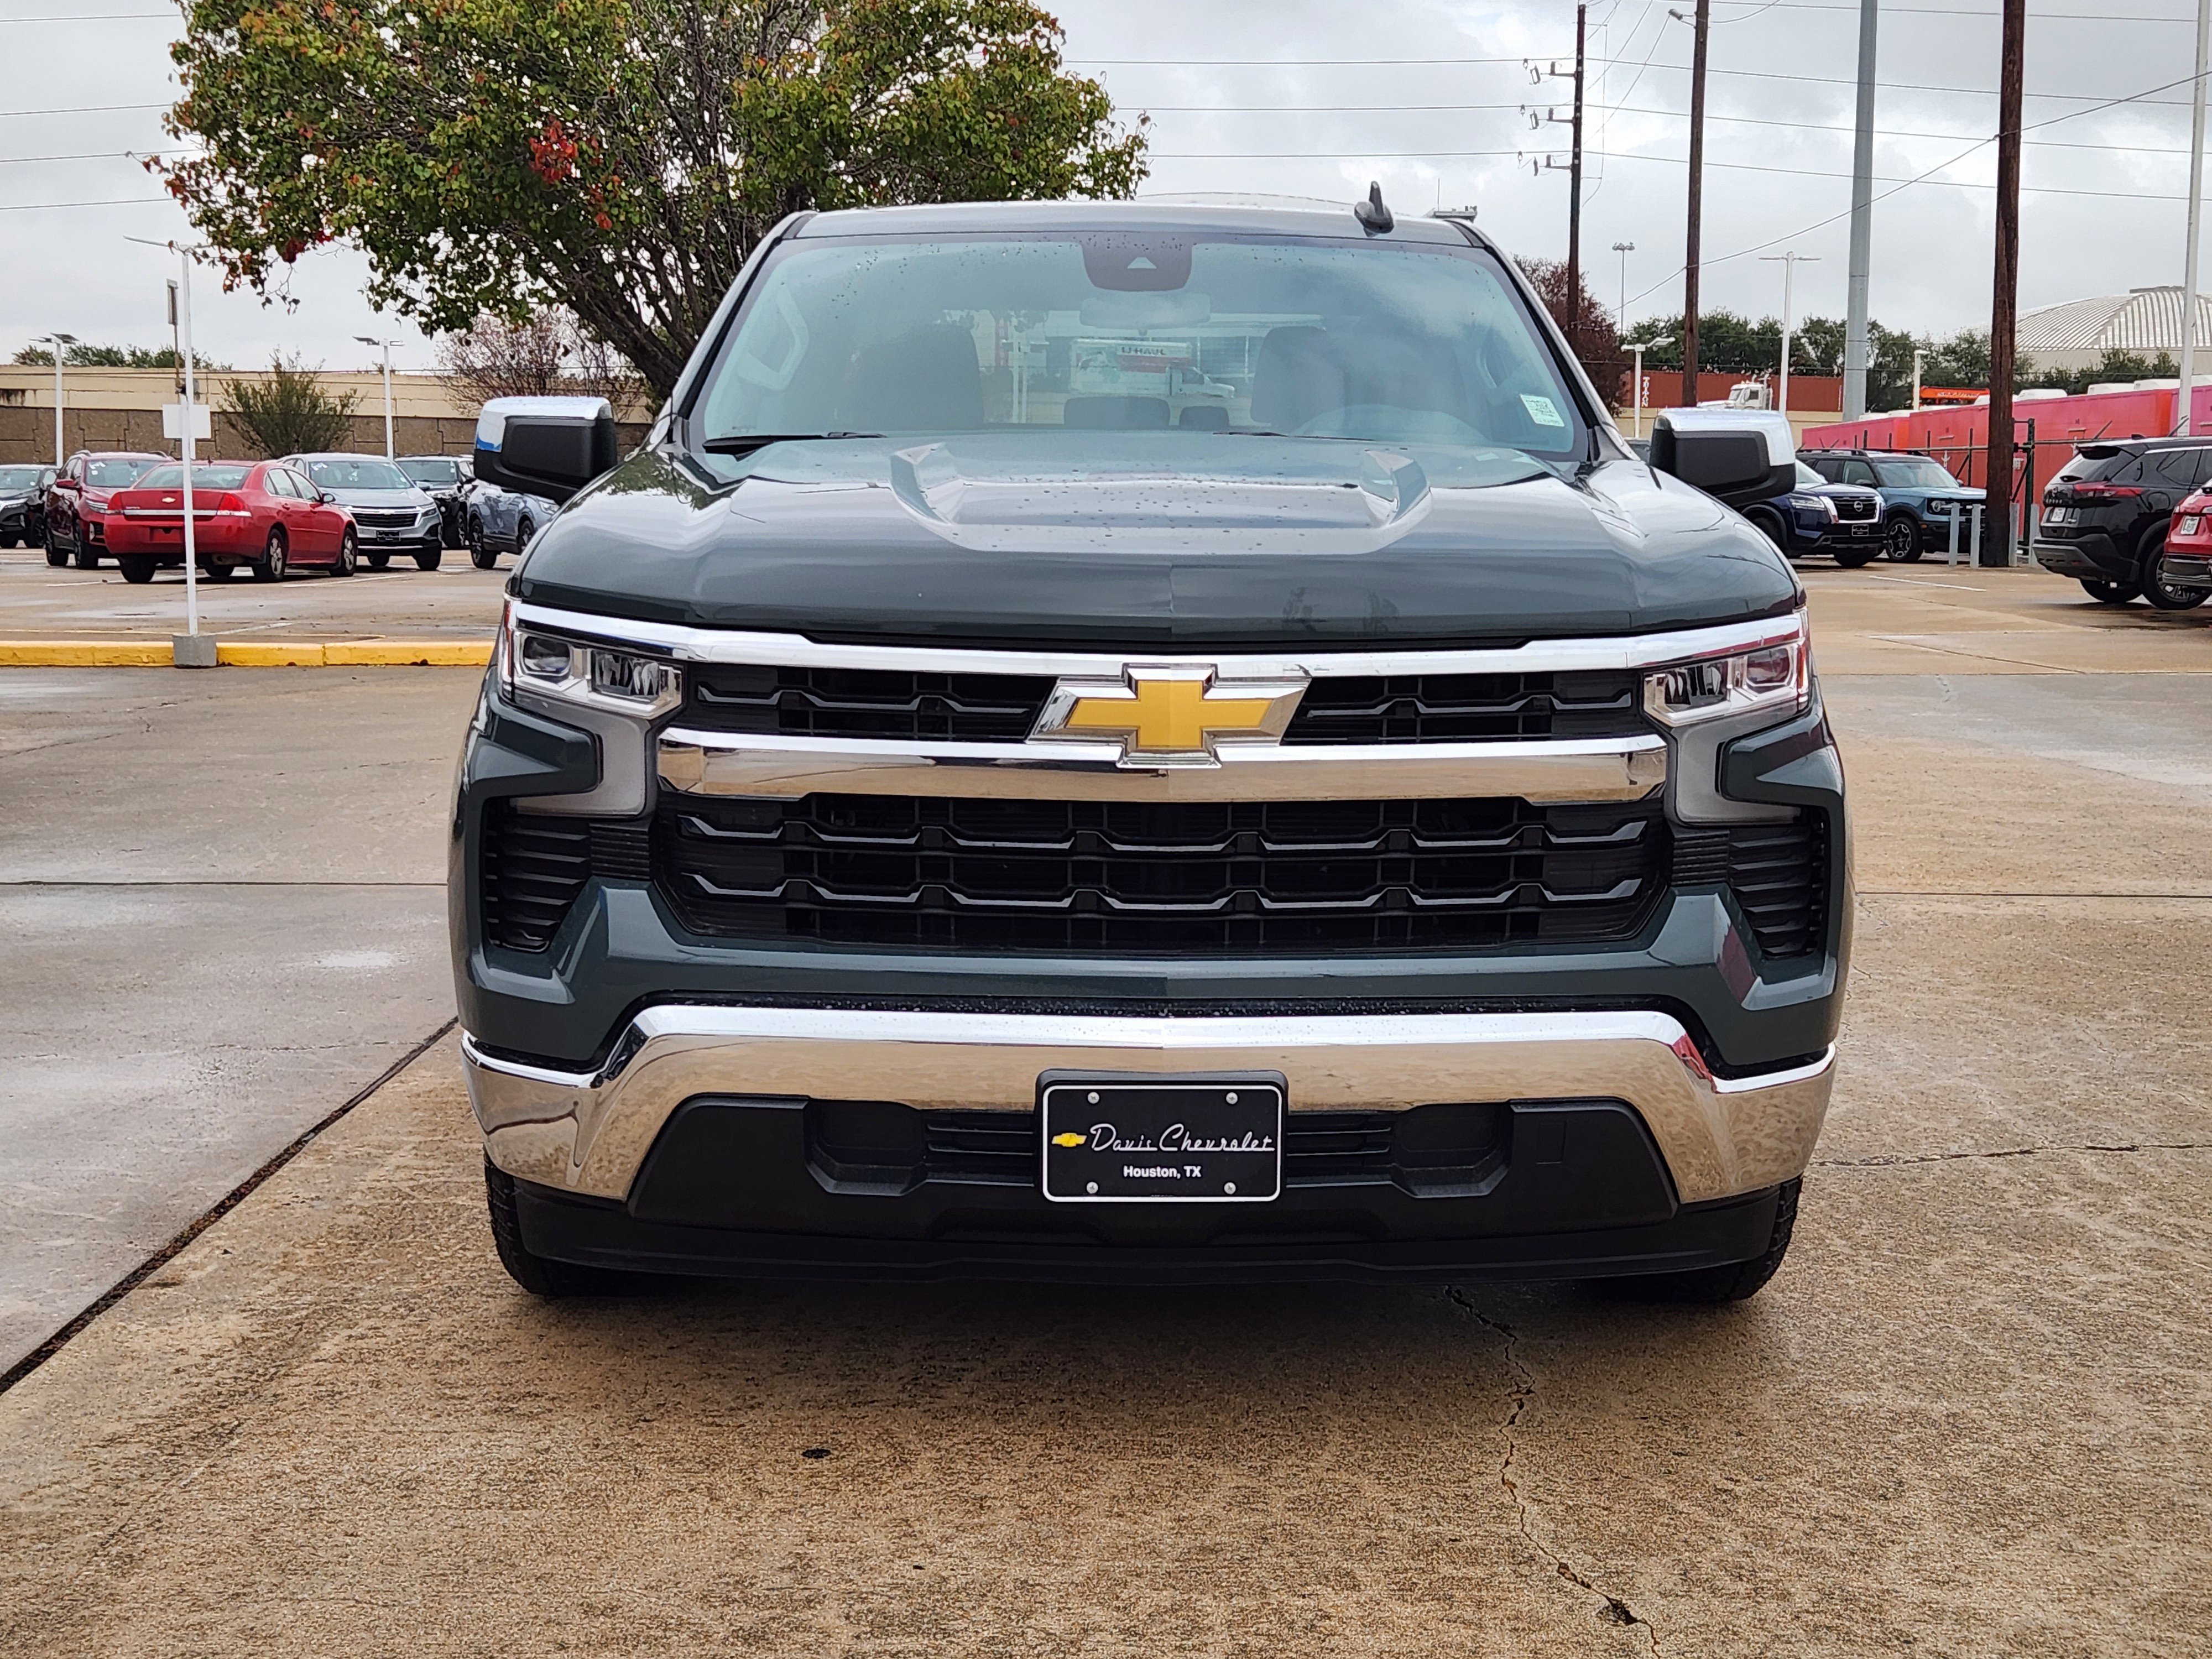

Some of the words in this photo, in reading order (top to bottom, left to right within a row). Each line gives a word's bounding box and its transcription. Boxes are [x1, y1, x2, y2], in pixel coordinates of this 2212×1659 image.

[1089, 1123, 1158, 1152] Davis
[1159, 1123, 1276, 1152] Chevrolet
[1123, 1165, 1181, 1180] Houston,
[1183, 1165, 1202, 1178] TX
